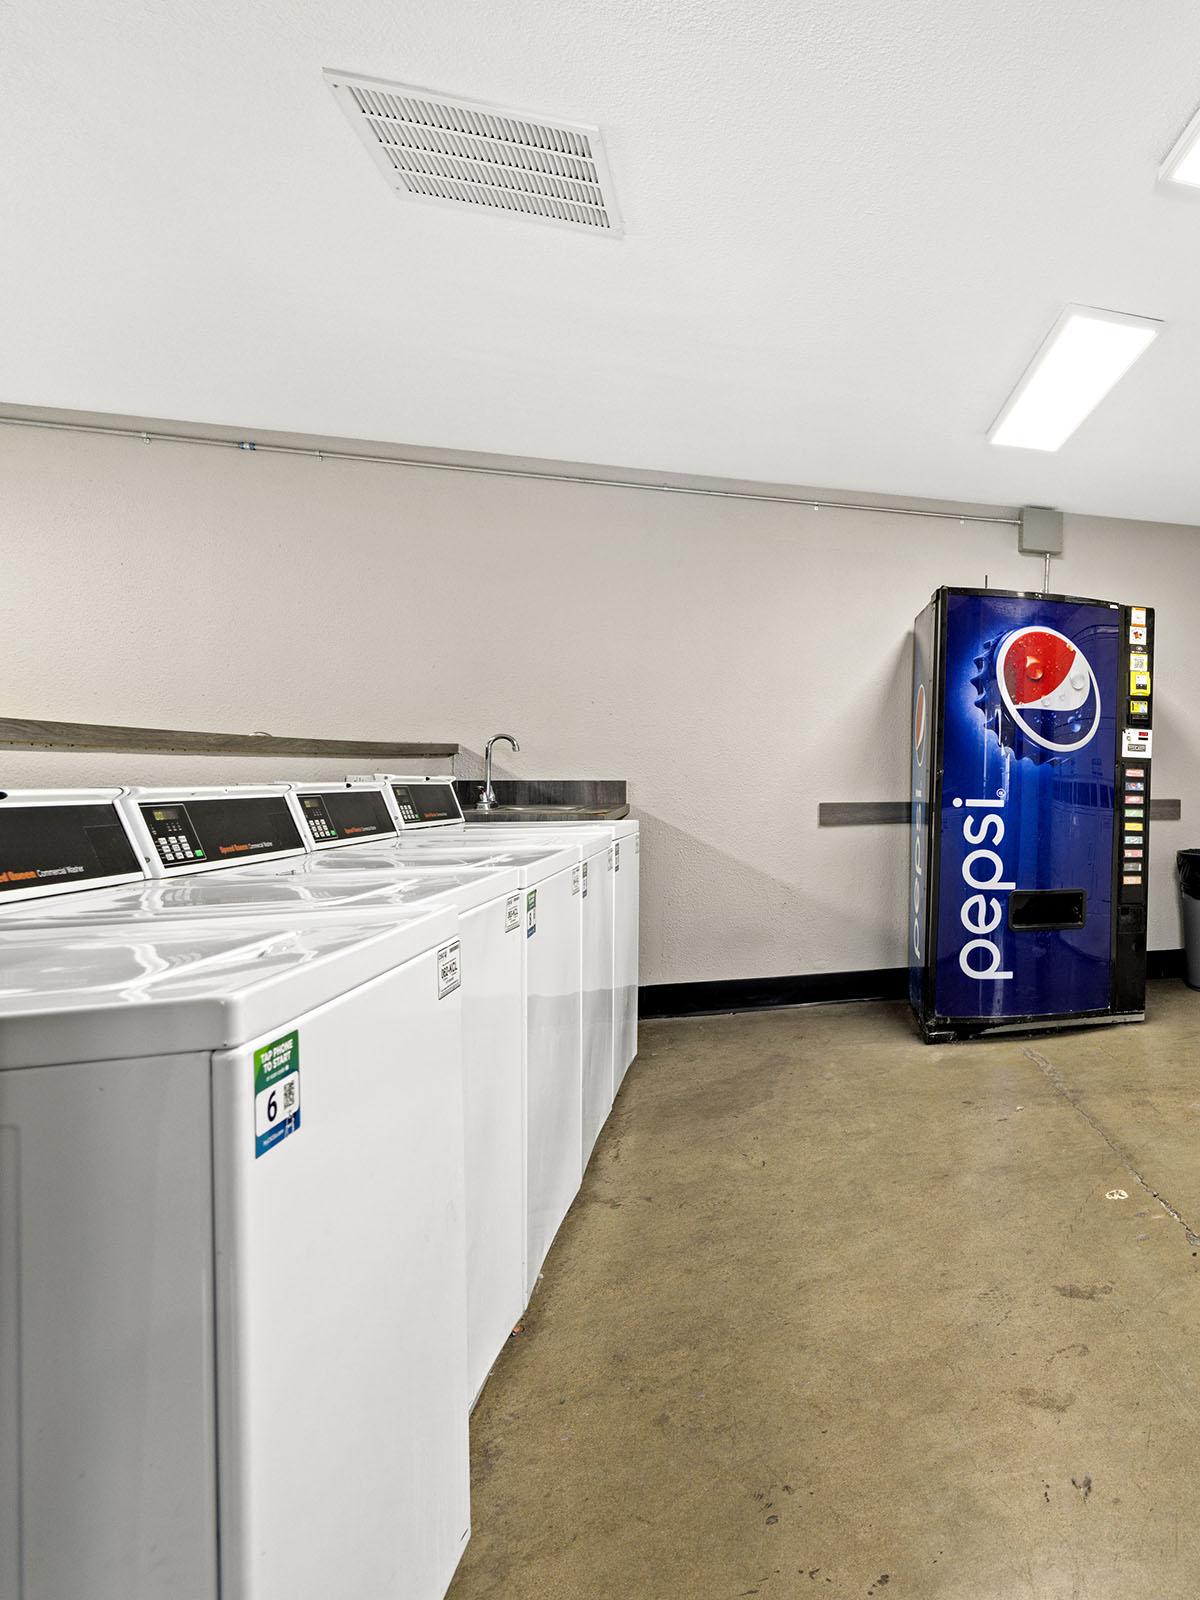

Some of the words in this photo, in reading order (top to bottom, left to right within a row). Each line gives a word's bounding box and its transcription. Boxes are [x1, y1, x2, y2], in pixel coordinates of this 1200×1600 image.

[952, 797, 1016, 980] pepsi
[261, 1048, 273, 1063] TAP
[273, 1039, 294, 1057] PHONE
[264, 1062, 272, 1074] TO
[272, 1051, 292, 1069] START
[267, 1090, 278, 1122] 6
